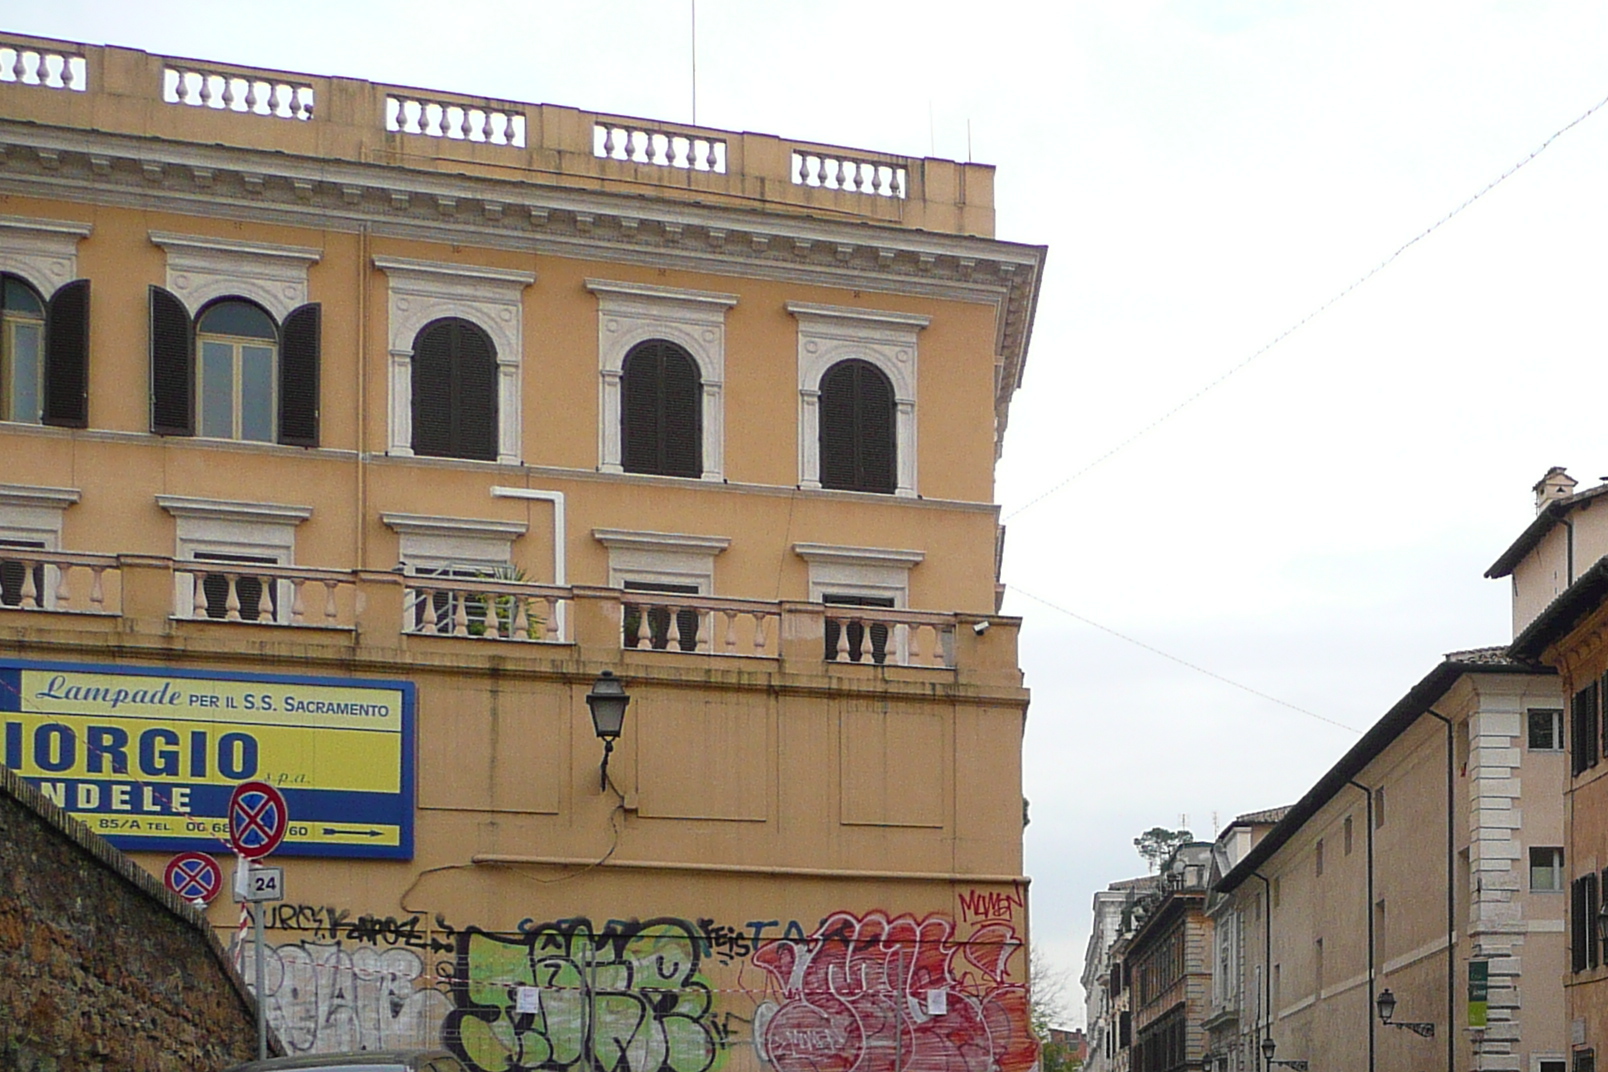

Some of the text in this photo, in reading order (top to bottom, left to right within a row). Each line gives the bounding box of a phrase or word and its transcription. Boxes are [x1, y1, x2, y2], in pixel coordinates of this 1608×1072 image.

[35, 675, 389, 718] Lampade PER IL S.S. SACRAMENTO
[99, 818, 141, 831] 85/A
[255, 877, 276, 891] 24
